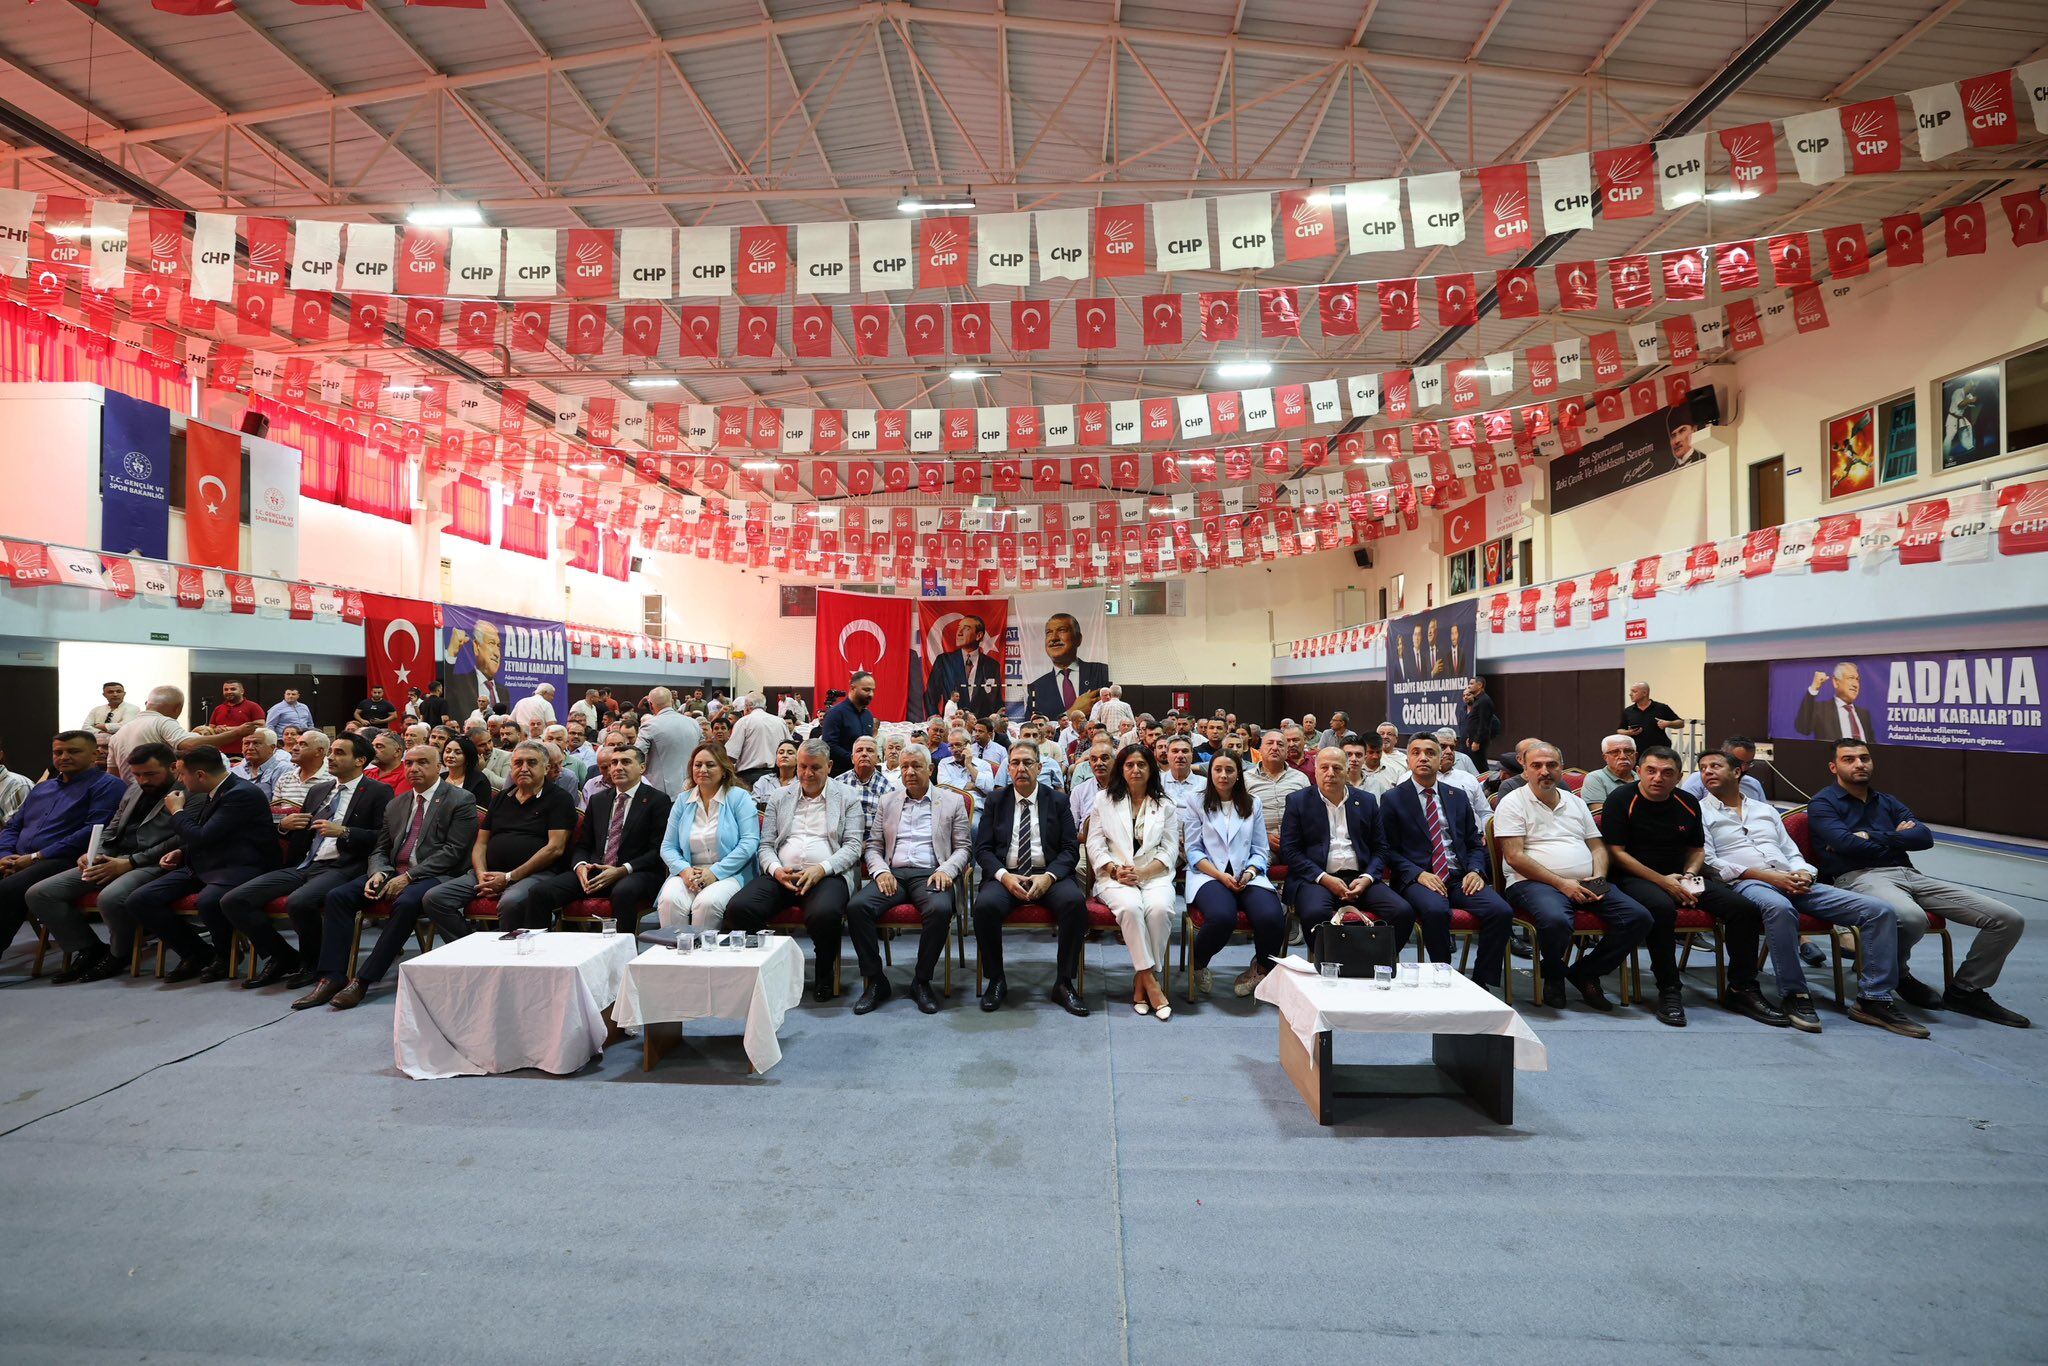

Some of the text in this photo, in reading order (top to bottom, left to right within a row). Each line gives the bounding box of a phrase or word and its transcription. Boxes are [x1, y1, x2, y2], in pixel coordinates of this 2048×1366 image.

[2034, 86, 2048, 101] CH
[1920, 109, 1951, 129] CHP
[1972, 112, 2007, 129] CHP
[1797, 137, 1829, 154] CHP
[1856, 140, 1887, 155] CHP
[1665, 159, 1700, 178] CHP
[1735, 164, 1763, 181] CHP
[1608, 186, 1642, 202] CHP
[1554, 194, 1589, 213] CHP
[1428, 212, 1459, 228] CHP
[1295, 223, 1324, 237] CHP
[1363, 221, 1396, 236] CHP
[1494, 220, 1528, 238] CHP
[101, 240, 128, 253] CHP
[1106, 242, 1134, 254] CHP
[1168, 238, 1202, 254] CHP
[1232, 235, 1266, 249] CHP
[51, 247, 79, 261] CHP
[202, 252, 230, 265] CHP
[930, 253, 958, 266] CHP
[989, 253, 1023, 267] CHP
[1051, 247, 1082, 262] CHP
[151, 259, 177, 275] CHP
[302, 260, 333, 275] CHP
[356, 262, 388, 276] CHP
[410, 260, 435, 273] CHP
[576, 264, 603, 277] CHP
[749, 261, 776, 274] CHP
[809, 263, 843, 276] CHP
[873, 257, 906, 273] CHP
[247, 268, 279, 285] CHP
[461, 266, 493, 280] CHP
[518, 266, 551, 279] CHP
[633, 268, 666, 281] CHP
[692, 265, 725, 279] CHP
[1798, 312, 1821, 326] CHP
[1639, 336, 1657, 348] CHP
[1735, 330, 1757, 343] CHP
[1673, 347, 1692, 358] CHP
[1597, 364, 1617, 375] CHP
[1421, 378, 1439, 389] CHP
[1533, 377, 1552, 388] CHP
[287, 388, 304, 399] CHP
[1357, 389, 1375, 399] CHP
[1454, 391, 1474, 402] CHP
[356, 400, 375, 410] CHP
[1285, 405, 1301, 414] CHP
[1316, 401, 1334, 411] CHP
[423, 410, 442, 419] CHP
[559, 411, 576, 421] CHP
[1218, 412, 1235, 421] CHP
[1249, 409, 1267, 419] CHP
[503, 420, 521, 429] CHP
[625, 417, 642, 426] CHP
[1085, 423, 1102, 432] CHP
[1115, 422, 1134, 431] CHP
[1151, 419, 1168, 428] CHP
[1185, 417, 1203, 427] CHP
[591, 429, 610, 439] CHP
[724, 427, 741, 435] CHP
[759, 429, 776, 437] CHP
[786, 429, 804, 439] CHP
[819, 429, 836, 438] CHP
[852, 430, 870, 439] CHP
[884, 430, 901, 438] CHP
[914, 430, 932, 439] CHP
[951, 430, 968, 438] CHP
[982, 431, 1000, 440] CHP
[1017, 427, 1034, 435] CHP
[1049, 426, 1068, 435] CHP
[656, 434, 675, 443] CHP
[109, 475, 122, 484] T.C.
[124, 479, 154, 491] GENÇLİK
[109, 482, 164, 500] SPOR BAKANLIĞI
[1125, 510, 1138, 518] CHP
[1951, 522, 1985, 537] CHP
[1905, 532, 1937, 547] CHP
[1784, 544, 1805, 555] CHP
[1819, 544, 1844, 556] CHP
[1752, 550, 1773, 563] CHP
[16, 568, 50, 579] CHP
[70, 564, 93, 575] CHP
[1667, 570, 1681, 581] CHP
[146, 581, 165, 592] CHP
[1638, 579, 1654, 587] CHP
[180, 592, 200, 602] CHP
[206, 589, 225, 599] CHP
[235, 595, 254, 604] CHP
[264, 596, 281, 605] CHP
[294, 602, 310, 611] CHP
[320, 602, 335, 611] CHP
[346, 607, 361, 616] CHP
[505, 624, 564, 661] ADANA
[1394, 677, 1468, 695] BELEDİYE BAŞKANLARIMIZA
[1887, 656, 2041, 705] ADANA
[1402, 696, 1458, 725] ÖZGÜRLÜK
[1887, 707, 1936, 723] ZEYDAN
[1933, 727, 1970, 735] edilemez,
[1888, 733, 1914, 741] Adanalı
[1951, 736, 1976, 745] boyun
[1977, 738, 2005, 746] eğmez.
